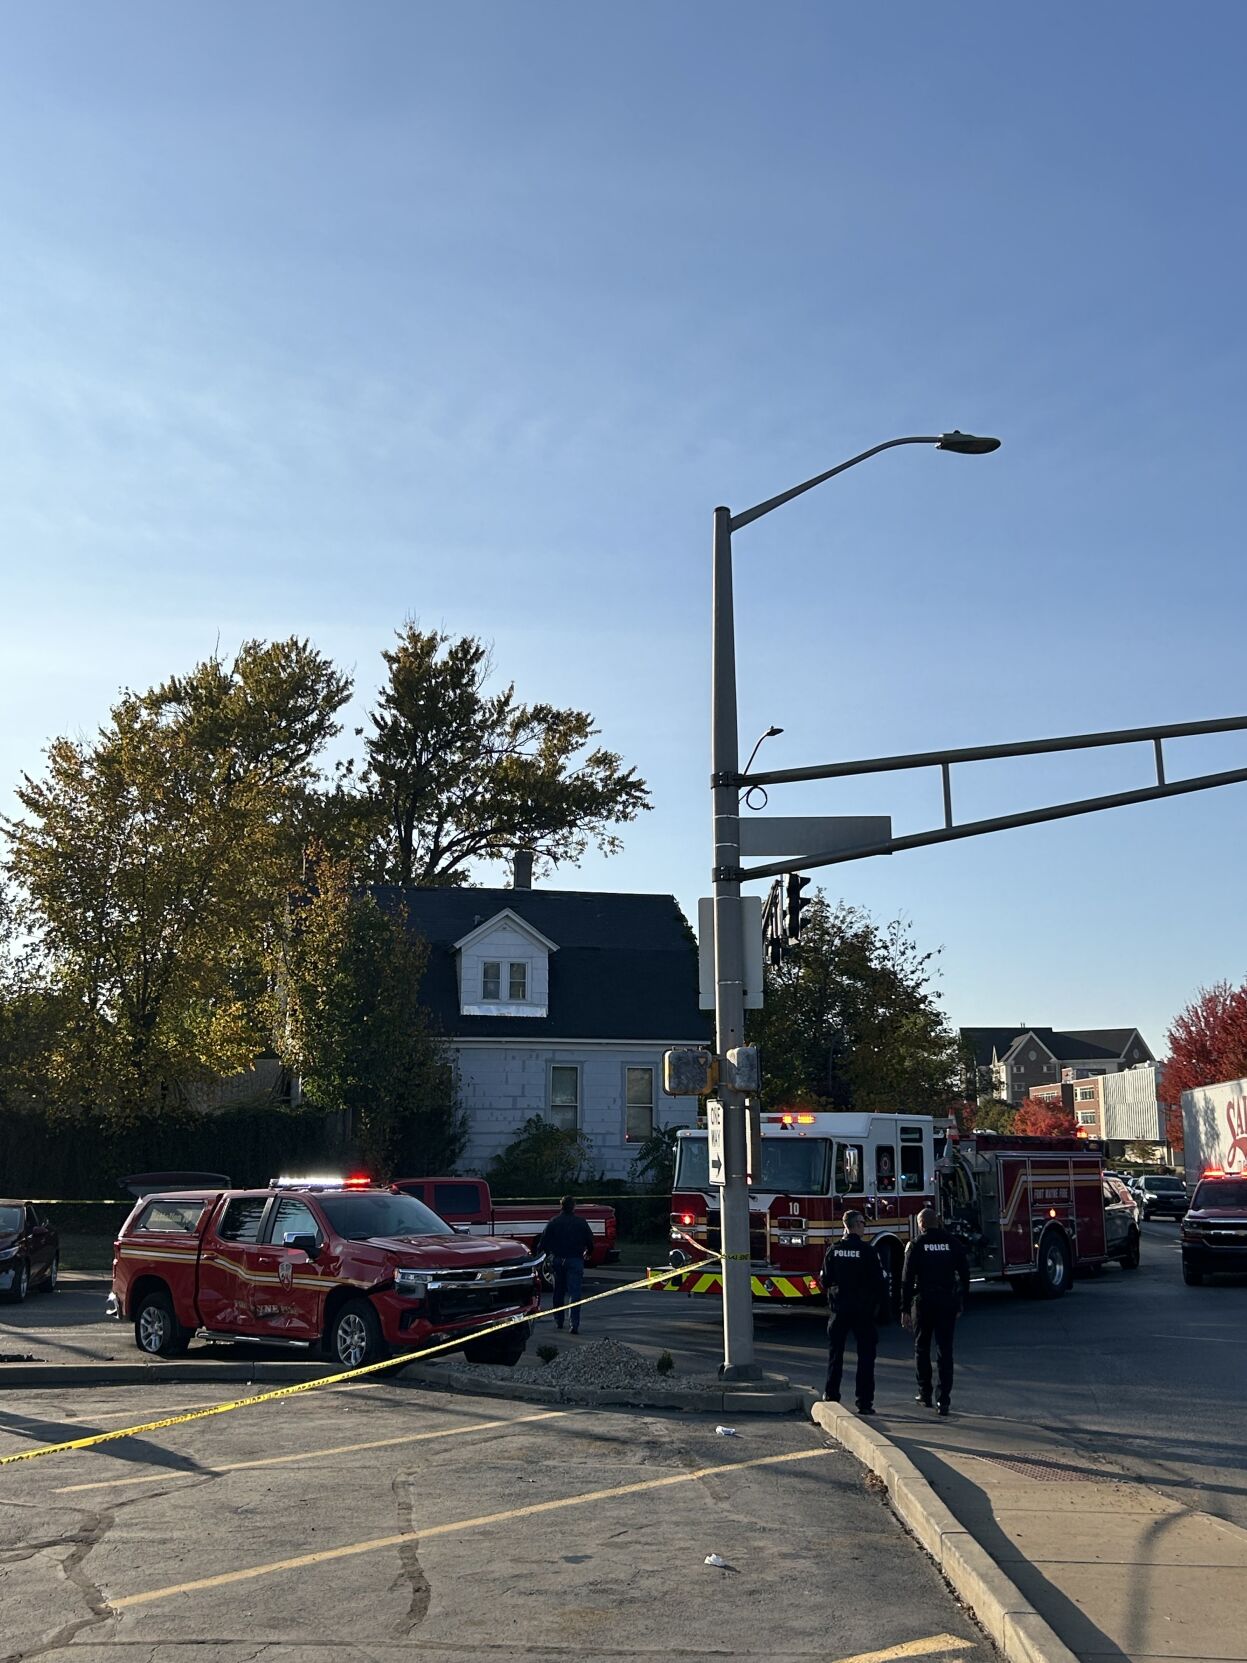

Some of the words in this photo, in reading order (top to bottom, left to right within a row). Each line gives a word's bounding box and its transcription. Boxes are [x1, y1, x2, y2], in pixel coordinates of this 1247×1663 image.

[711, 1107, 721, 1125] ONE
[711, 1129, 721, 1147] WAY
[788, 1202, 800, 1215] 10
[834, 1249, 861, 1258] POLICE
[924, 1243, 950, 1251] POLICE
